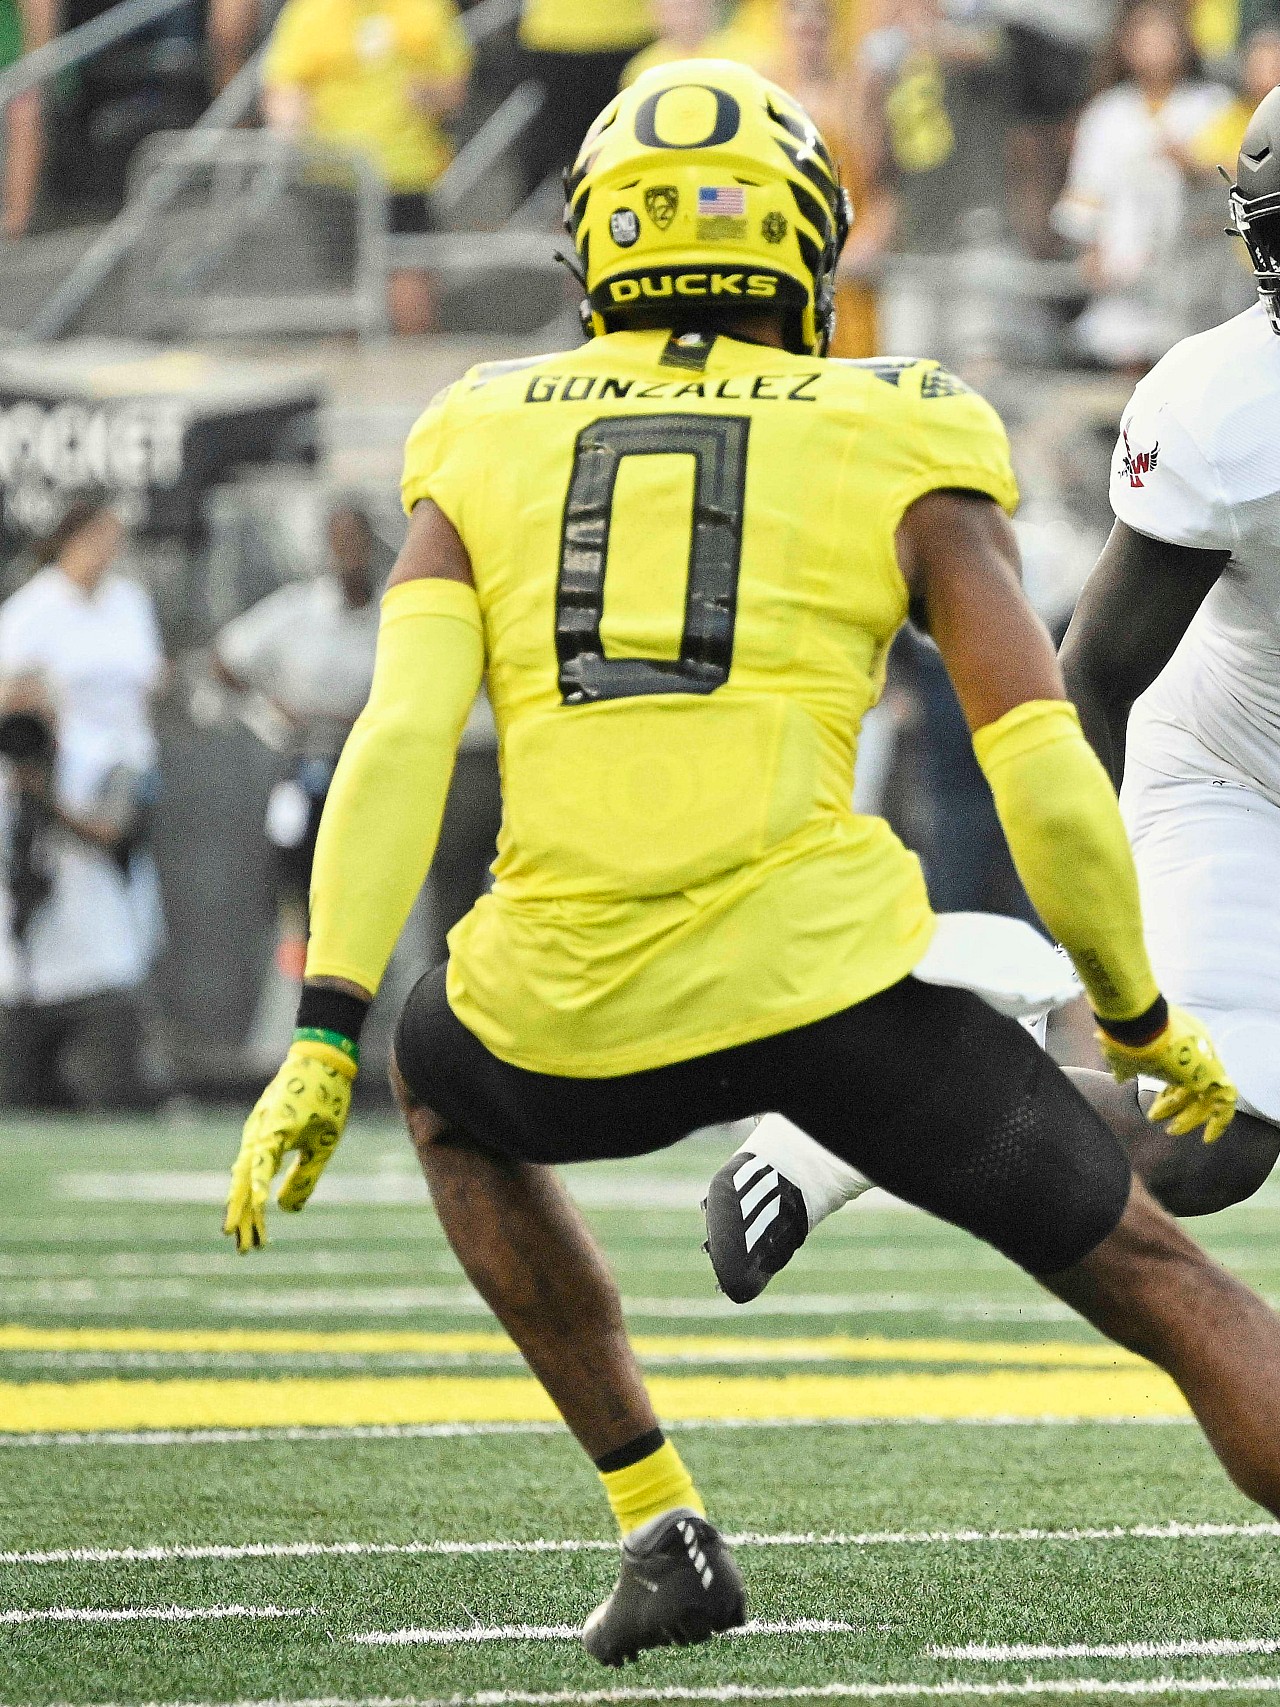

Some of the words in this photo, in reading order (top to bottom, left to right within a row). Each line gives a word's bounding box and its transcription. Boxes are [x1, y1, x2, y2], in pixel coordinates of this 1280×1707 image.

[609, 273, 779, 302] DUCKS
[524, 372, 822, 403] GONZALEZ
[554, 411, 752, 706] 0
